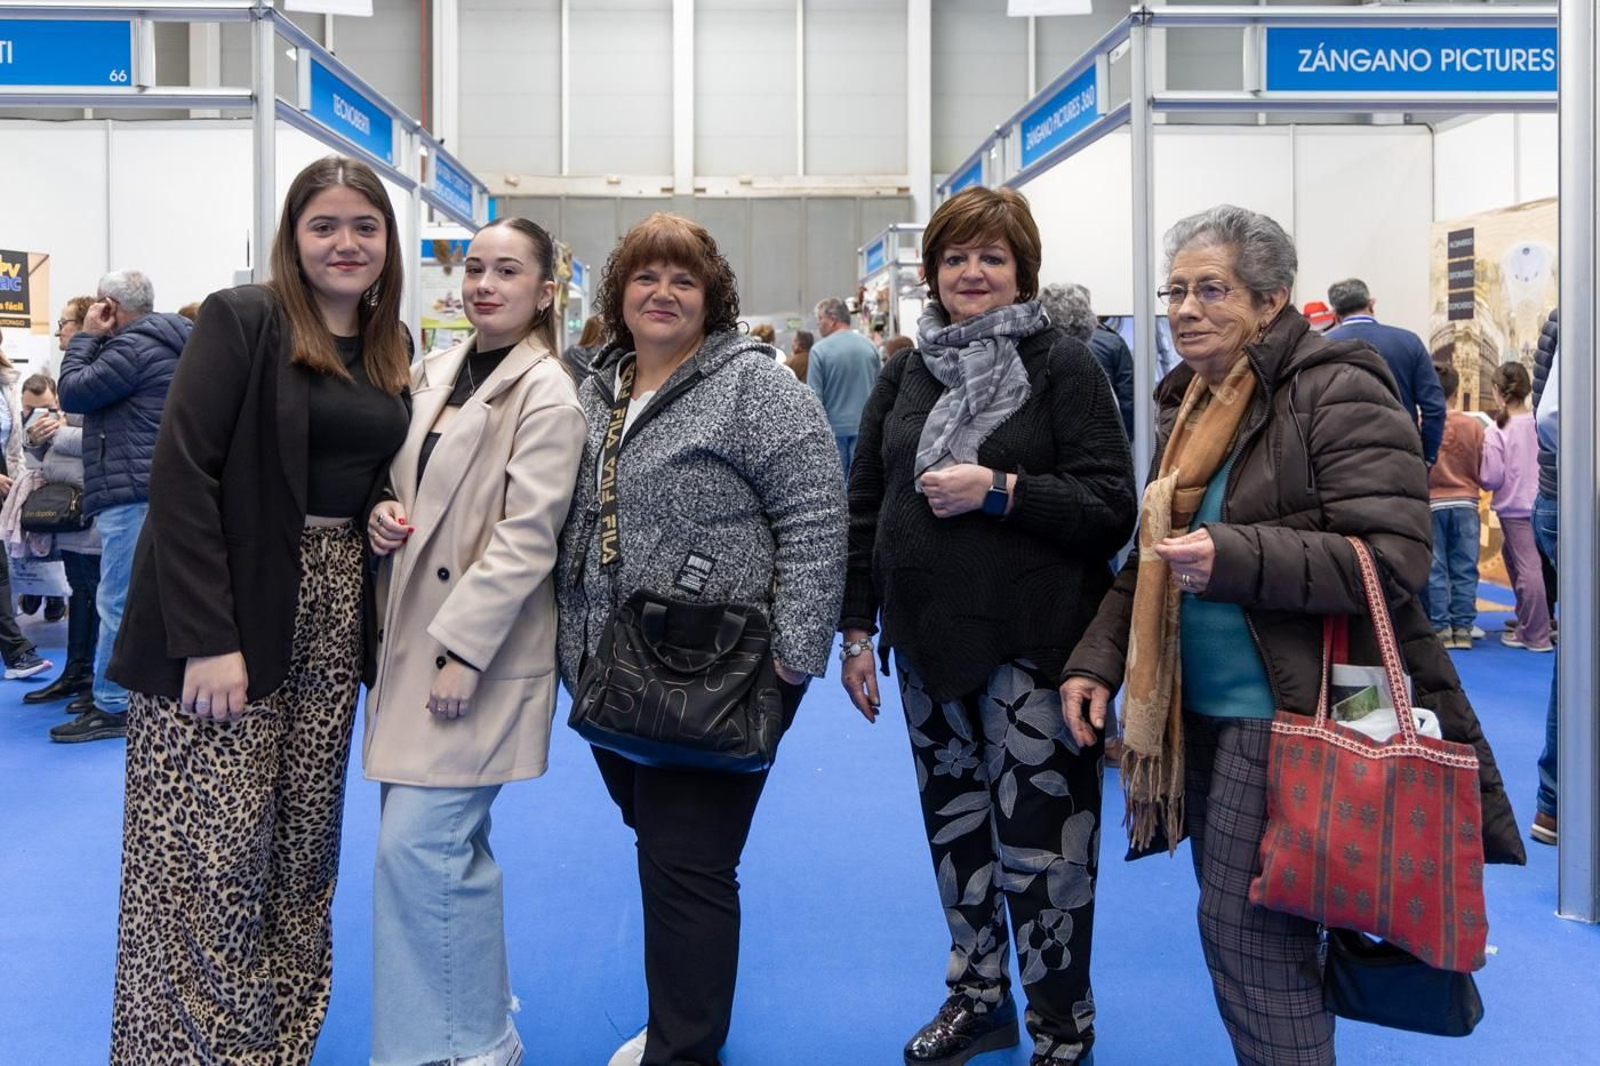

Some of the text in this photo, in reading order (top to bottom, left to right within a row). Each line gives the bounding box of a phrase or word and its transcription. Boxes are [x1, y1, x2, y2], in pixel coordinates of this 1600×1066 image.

[109, 69, 128, 82] 66
[1298, 42, 1555, 72] ZÁNGANO PICTURES
[1053, 95, 1080, 132] PICTURES
[1081, 84, 1095, 112] 360
[606, 405, 627, 449] FILA
[601, 455, 616, 504] FILA
[577, 513, 594, 552] DANCE
[601, 514, 618, 564] FILA
